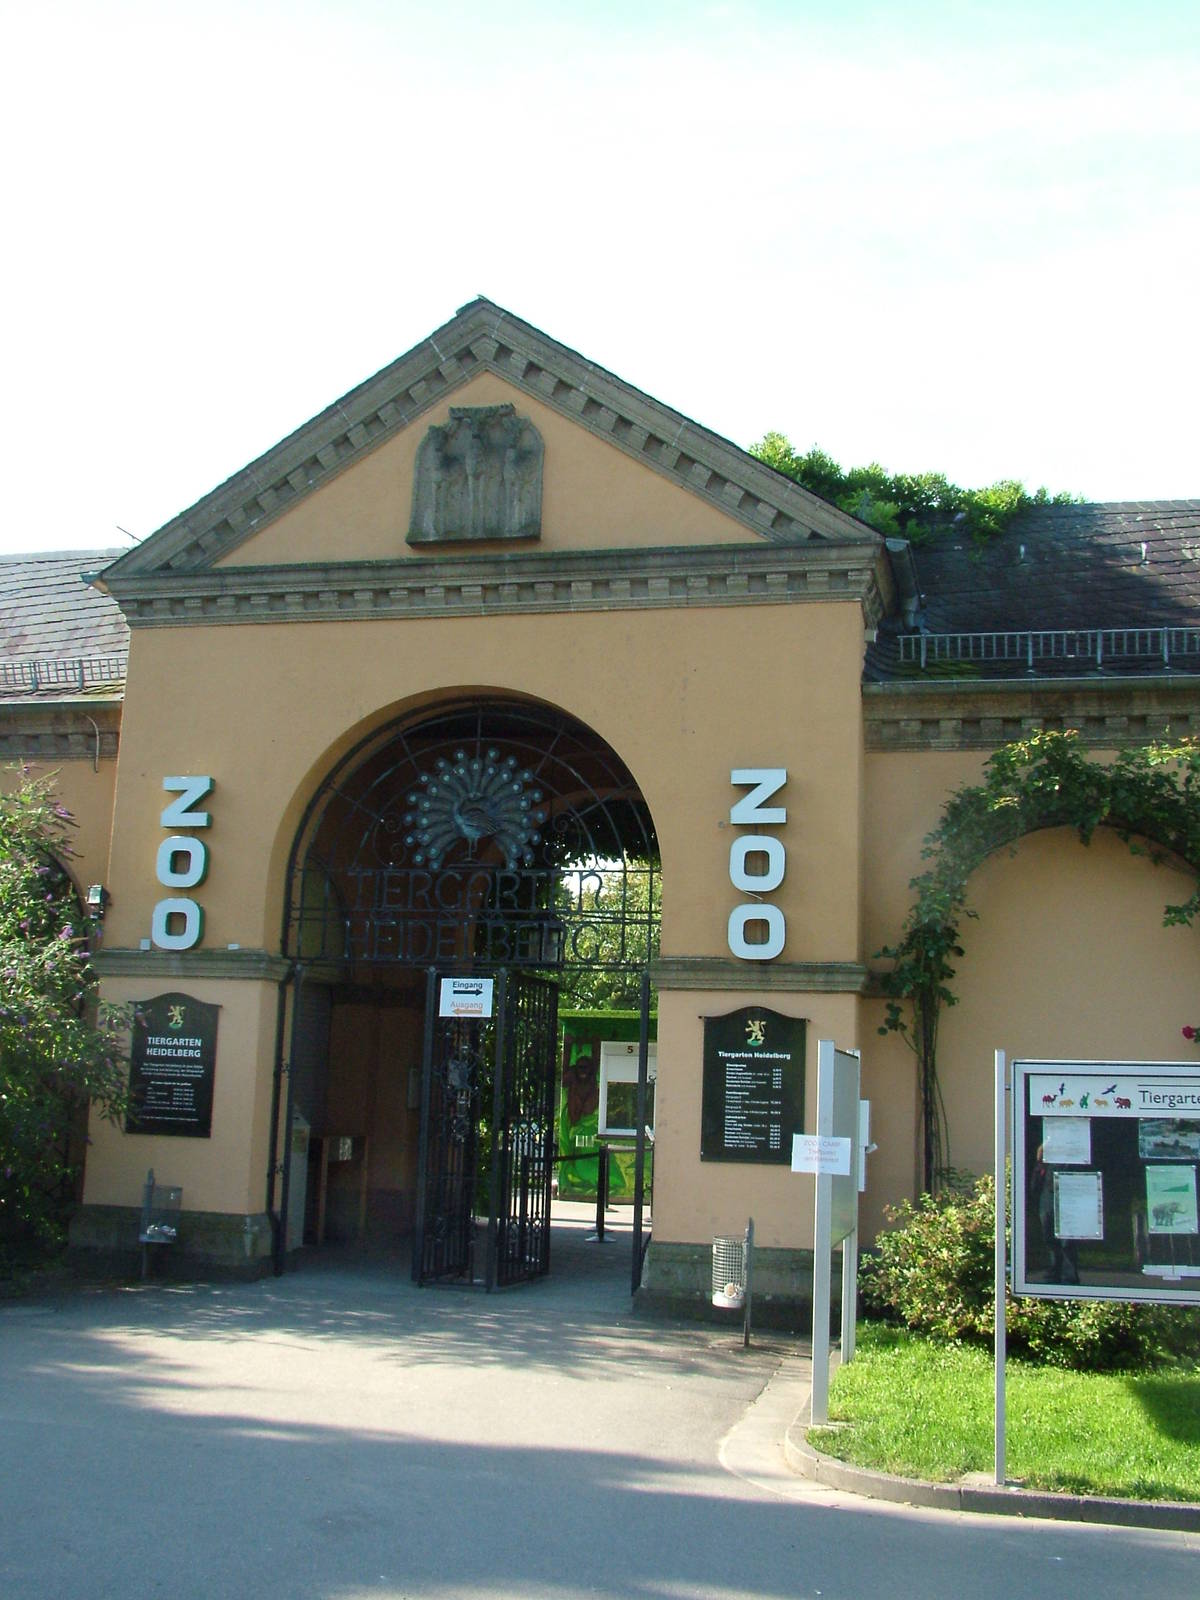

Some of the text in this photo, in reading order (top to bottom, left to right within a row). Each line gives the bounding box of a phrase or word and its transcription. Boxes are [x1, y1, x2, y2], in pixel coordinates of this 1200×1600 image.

[151, 775, 215, 951] ZOO
[727, 768, 787, 960] ZOO
[452, 981, 483, 990] Eingang
[450, 1001, 483, 1009] Ausgang
[147, 1036, 202, 1046] TIERGARTEN
[146, 1047, 201, 1058] HEIDELBERG
[718, 1051, 791, 1060] Tiergarten Heidelberg
